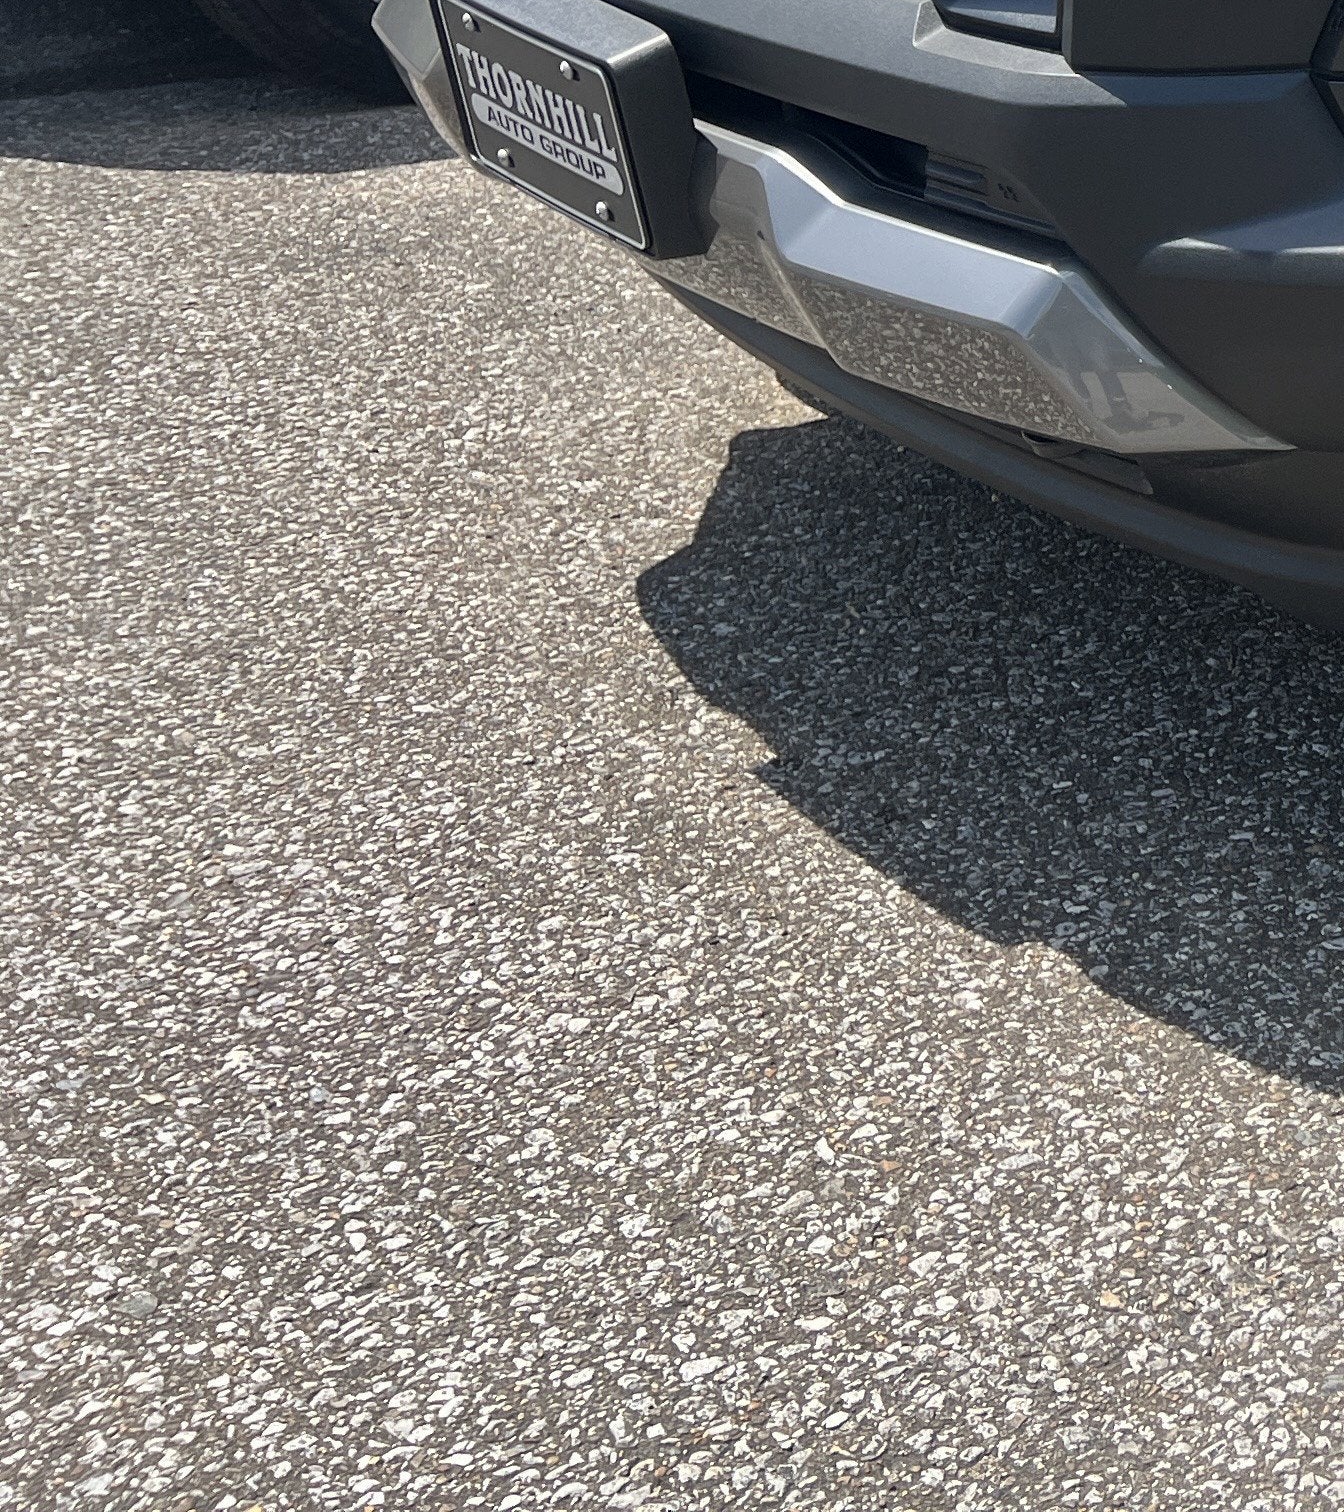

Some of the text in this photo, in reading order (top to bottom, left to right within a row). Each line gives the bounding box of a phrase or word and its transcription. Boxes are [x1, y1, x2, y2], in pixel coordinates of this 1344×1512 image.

[455, 42, 618, 163] THORNHILL
[487, 105, 607, 181] AUTO GROUP
